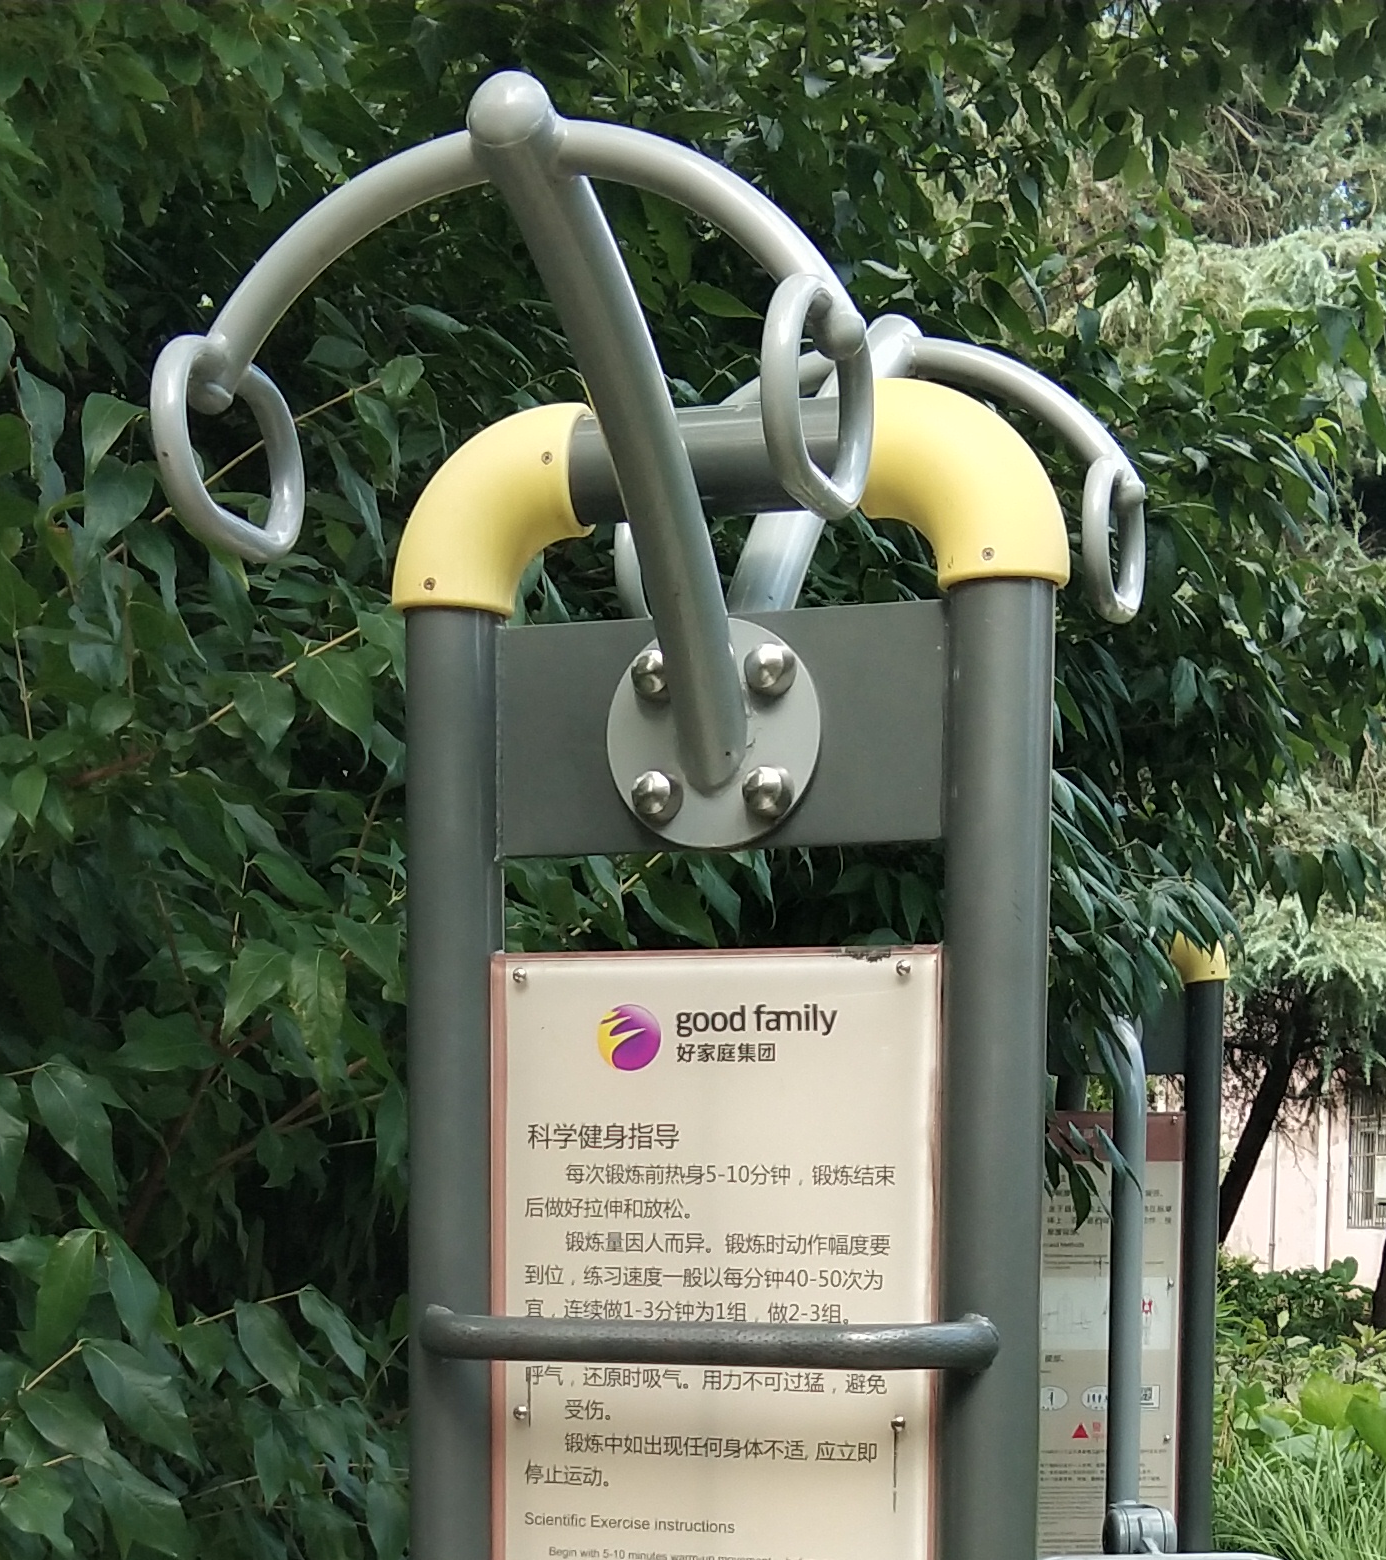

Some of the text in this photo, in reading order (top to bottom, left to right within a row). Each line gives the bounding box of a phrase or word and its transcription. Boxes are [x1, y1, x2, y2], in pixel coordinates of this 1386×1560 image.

[676, 1004, 837, 1035] good family
[676, 1043, 775, 1063] 好家庭集团
[528, 1123, 679, 1150] 科学健身指导
[525, 1198, 690, 1220] 后做好拉伸和放松。
[565, 1400, 612, 1421] 受伤。
[525, 1462, 609, 1488] 停止运动。
[524, 1512, 735, 1533] Scientific Exercise instructions
[549, 1547, 576, 1558] Begin
[580, 1549, 599, 1558] with
[603, 1549, 625, 1559] 5-10
[628, 1551, 667, 1560] minutes
